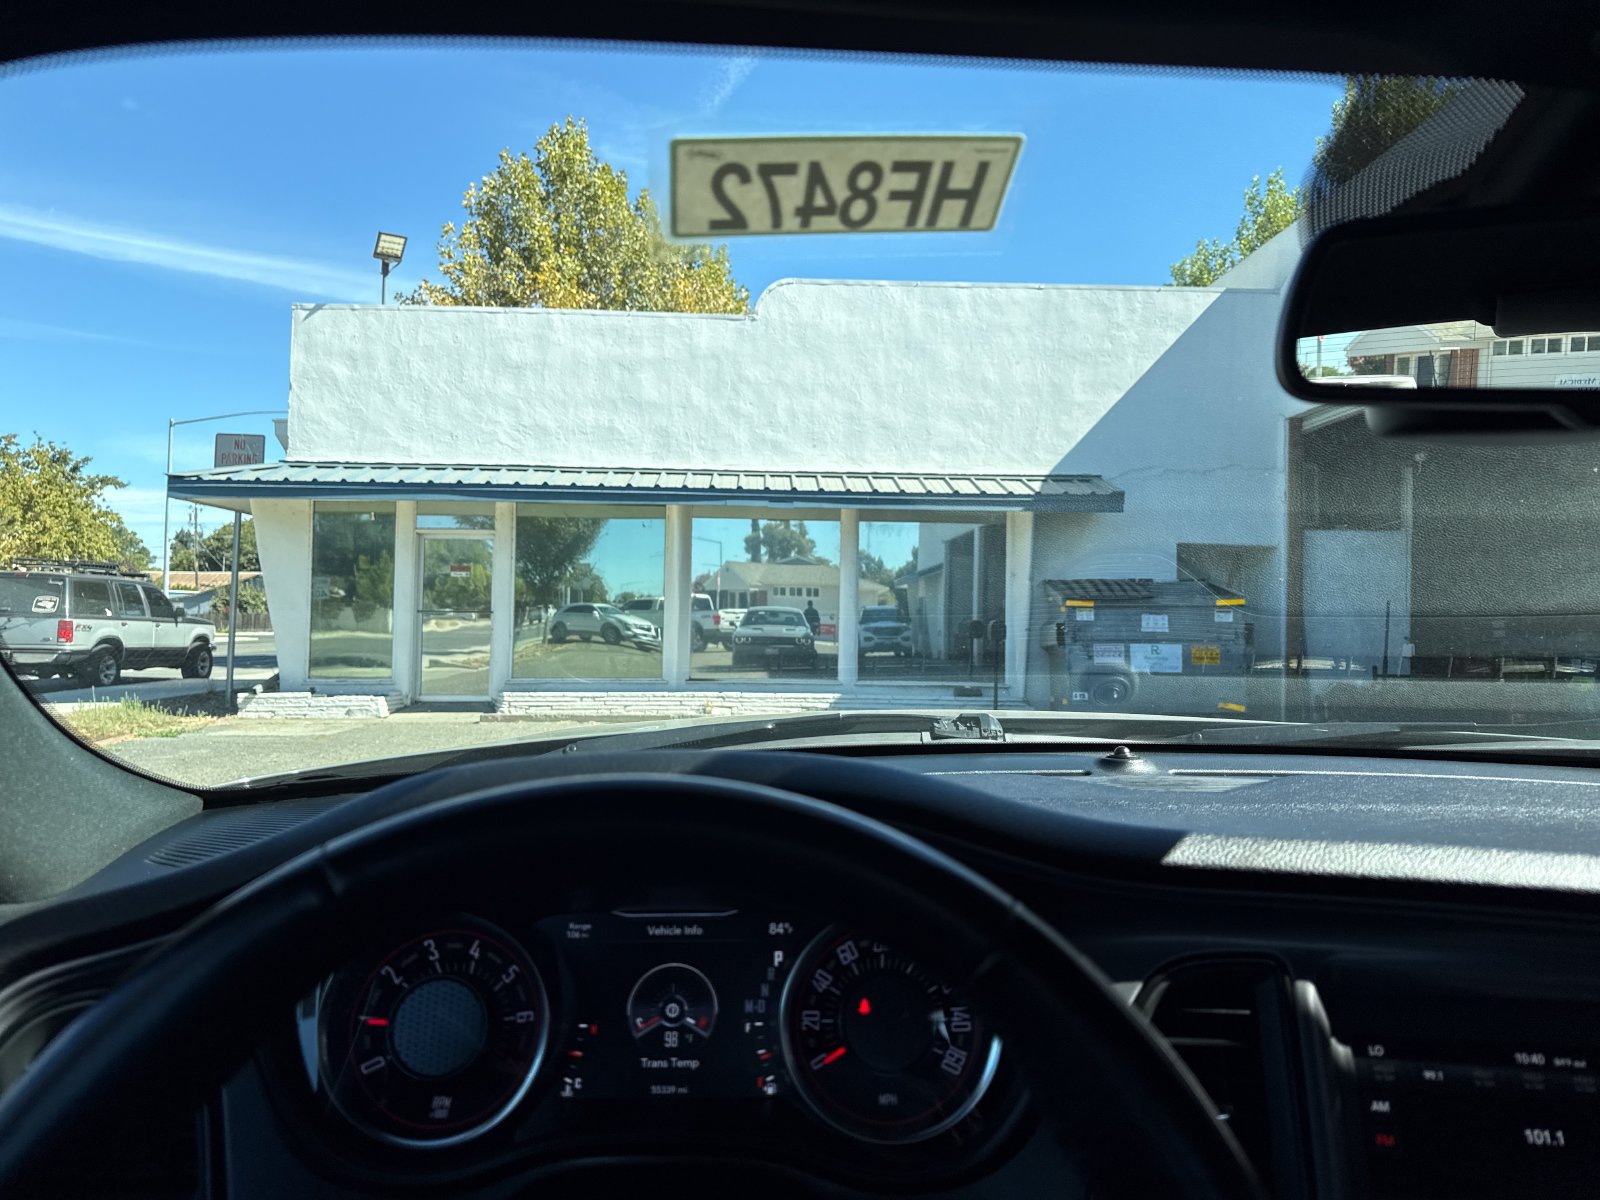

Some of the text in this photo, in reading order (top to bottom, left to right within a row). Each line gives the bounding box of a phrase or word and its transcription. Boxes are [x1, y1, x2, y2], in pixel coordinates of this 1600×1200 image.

[234, 439, 246, 450] NO
[221, 452, 258, 465] PARKING
[646, 924, 704, 936] Vehicle Info
[423, 939, 440, 961] 3
[469, 939, 480, 960] 4
[773, 950, 784, 968] P
[835, 940, 860, 966] 60
[380, 965, 404, 985] 2
[501, 964, 521, 984] 5
[811, 968, 834, 993] 40
[515, 1010, 534, 1024] 6
[801, 1009, 821, 1031] 20
[664, 1030, 679, 1048] 98
[360, 1056, 386, 1075] 0
[640, 1057, 700, 1071] Trans Temp
[940, 1048, 969, 1076] 160
[878, 1093, 898, 1106] MPH
[1370, 1099, 1391, 1113] AM
[1524, 1128, 1565, 1147] 101.1
